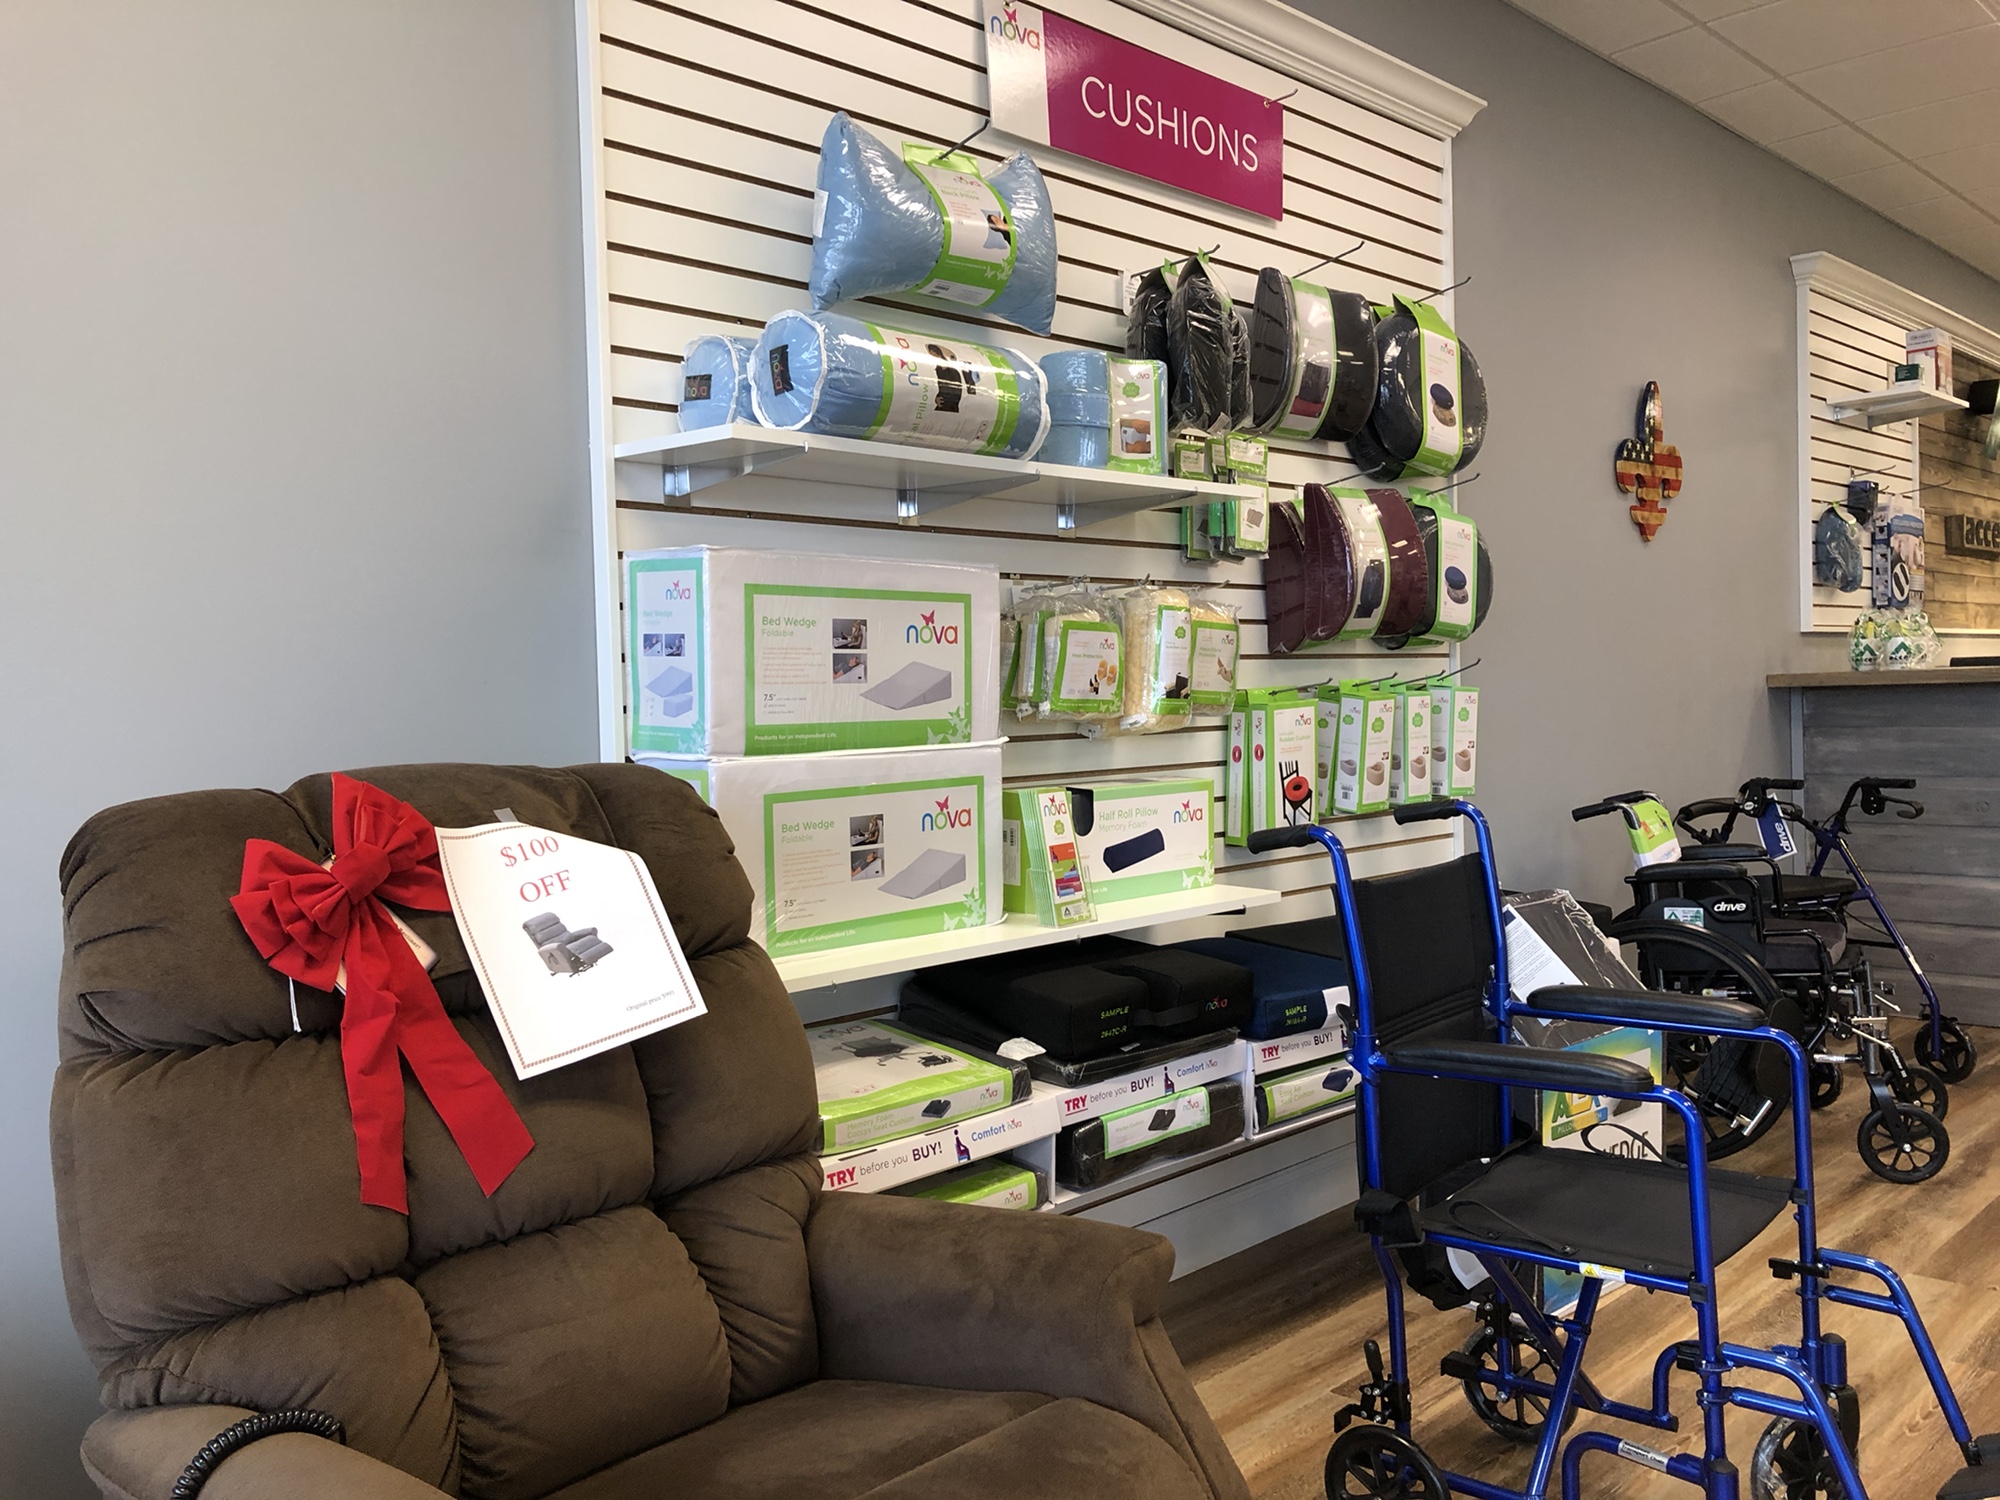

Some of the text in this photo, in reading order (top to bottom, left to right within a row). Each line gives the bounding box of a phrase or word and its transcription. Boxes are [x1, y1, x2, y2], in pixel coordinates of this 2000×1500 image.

[990, 15, 1041, 51] nova
[1080, 75, 1259, 173] CUSHIONS
[665, 587, 691, 600] nova
[762, 616, 817, 628] Bed Wedge
[762, 629, 794, 637] Foldable
[906, 624, 958, 645] nova
[1099, 642, 1115, 650] nova
[1295, 718, 1312, 726] nova
[1043, 802, 1067, 817] nova
[1099, 806, 1159, 821] Half Roll Pillow
[1173, 808, 1203, 824] nova
[781, 820, 835, 833] Bed Wedge
[921, 808, 972, 832] nova
[1099, 820, 1147, 832] Memory Foam
[781, 834, 813, 844] Foldable
[1774, 822, 1792, 852] drive
[500, 835, 560, 868] $100
[519, 869, 572, 903] OFF
[1713, 901, 1747, 912] drive
[626, 1000, 648, 1011] Original
[1100, 1005, 1130, 1019] SAMPLE
[1285, 1004, 1308, 1016] SAMPLE
[1261, 1032, 1334, 1060] TRY before you BUY!
[979, 1089, 999, 1101] nova
[1065, 1095, 1088, 1112] TRY
[1089, 1088, 1113, 1103] before
[1114, 1086, 1128, 1100] you
[1130, 1076, 1155, 1092] BUY!
[1176, 1063, 1205, 1078] Comfort
[1182, 1101, 1200, 1112] nova
[847, 1113, 895, 1131] Memory Foam
[847, 1116, 915, 1139] Coccyx Seat Cushion
[1603, 1131, 1649, 1160] EDGE
[826, 1166, 857, 1188] TRY
[860, 1159, 890, 1176] before
[892, 1154, 908, 1169] you
[912, 1141, 943, 1162] BUY!
[971, 1123, 1006, 1142] Comfort
[1004, 1190, 1023, 1205] nova
